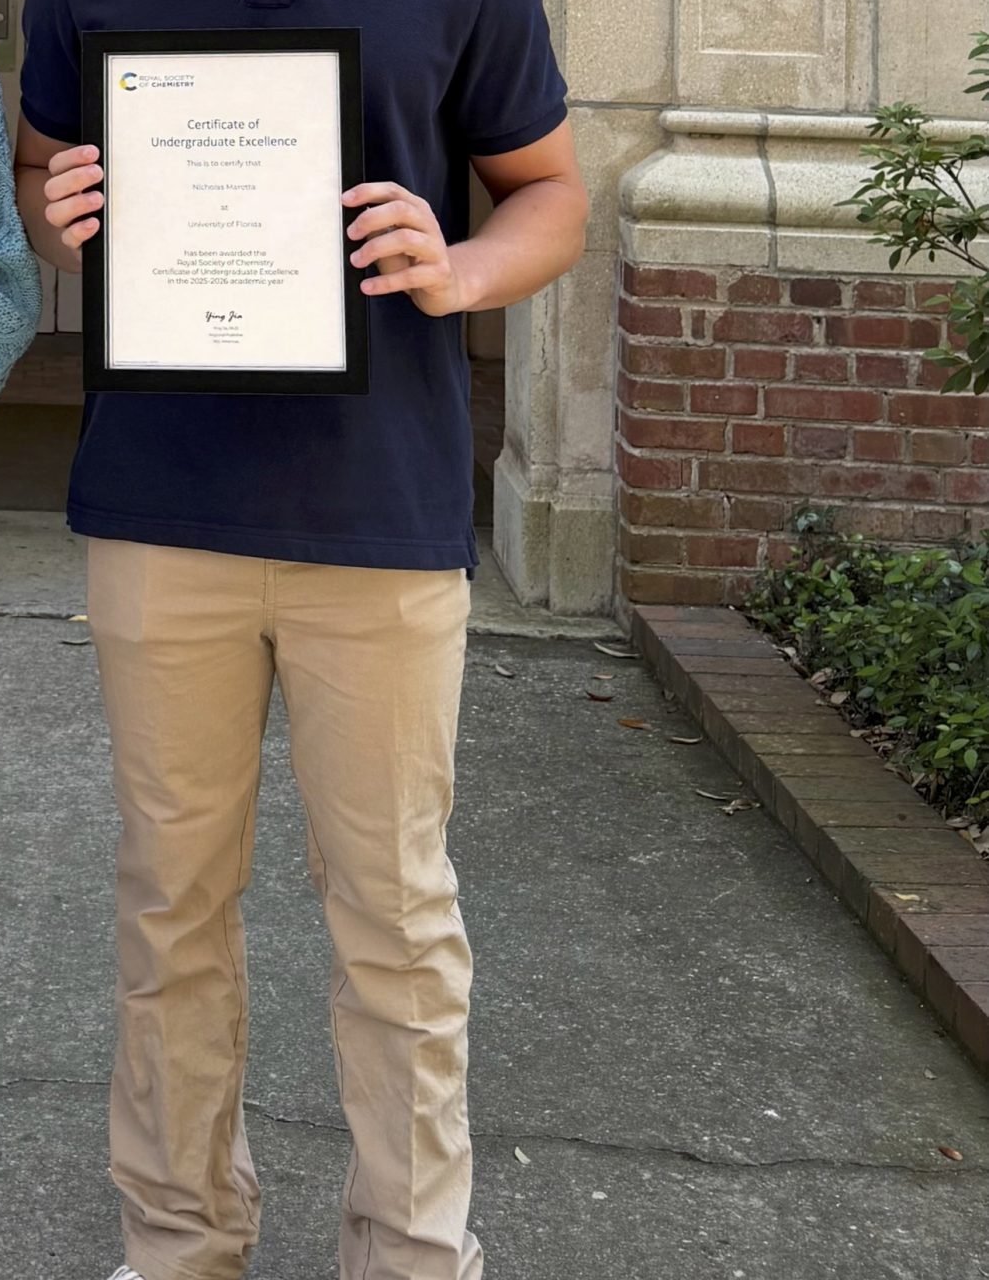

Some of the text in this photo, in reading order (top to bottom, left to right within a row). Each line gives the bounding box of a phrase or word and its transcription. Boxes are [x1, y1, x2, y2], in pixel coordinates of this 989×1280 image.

[187, 118, 260, 131] Certificate of
[151, 135, 298, 149] Undergraduate Excellence
[186, 159, 202, 167] This
[220, 159, 244, 168] certify
[246, 159, 262, 167] that
[188, 220, 262, 229] University of Florida
[177, 259, 275, 268] Royal Society of Chemistry
[152, 268, 300, 277] Certificate of Undergraduate Excellence
[167, 277, 284, 287] in the 2025-2026 academic year
